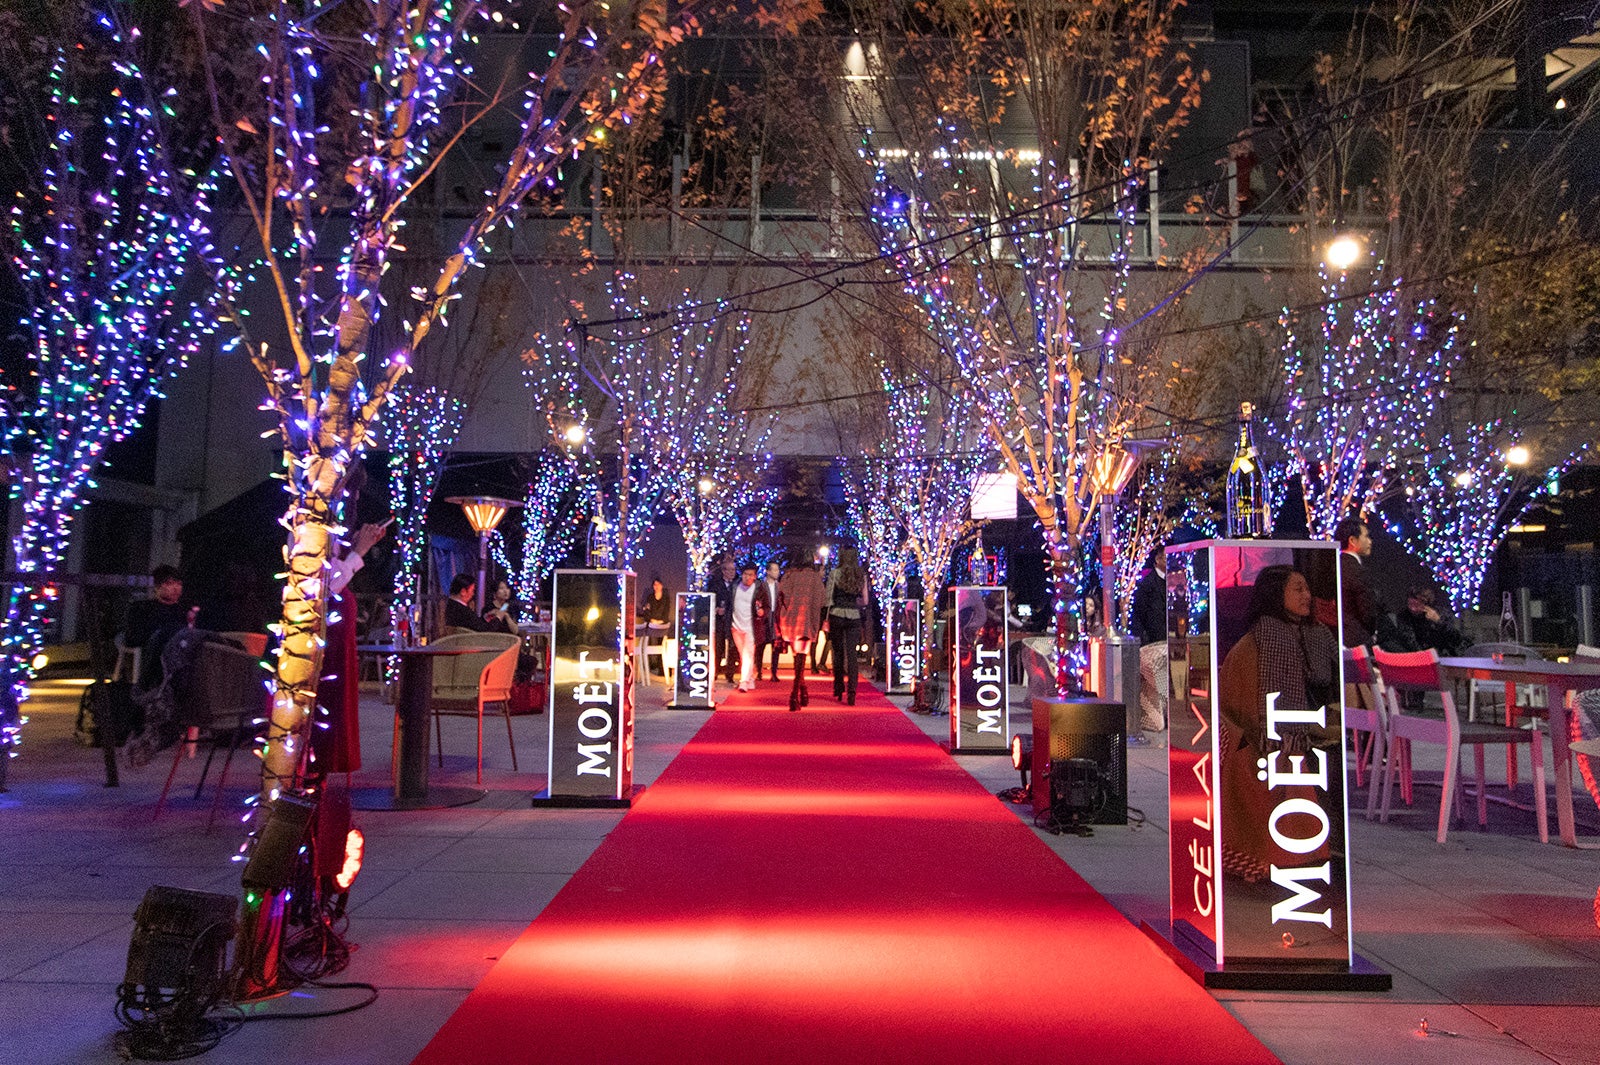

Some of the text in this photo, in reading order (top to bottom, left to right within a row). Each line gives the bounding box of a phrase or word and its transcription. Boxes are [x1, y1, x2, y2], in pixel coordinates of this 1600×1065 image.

[573, 651, 613, 778] MOËT
[972, 643, 1002, 735] MOËT
[1257, 692, 1332, 929] MOËT
